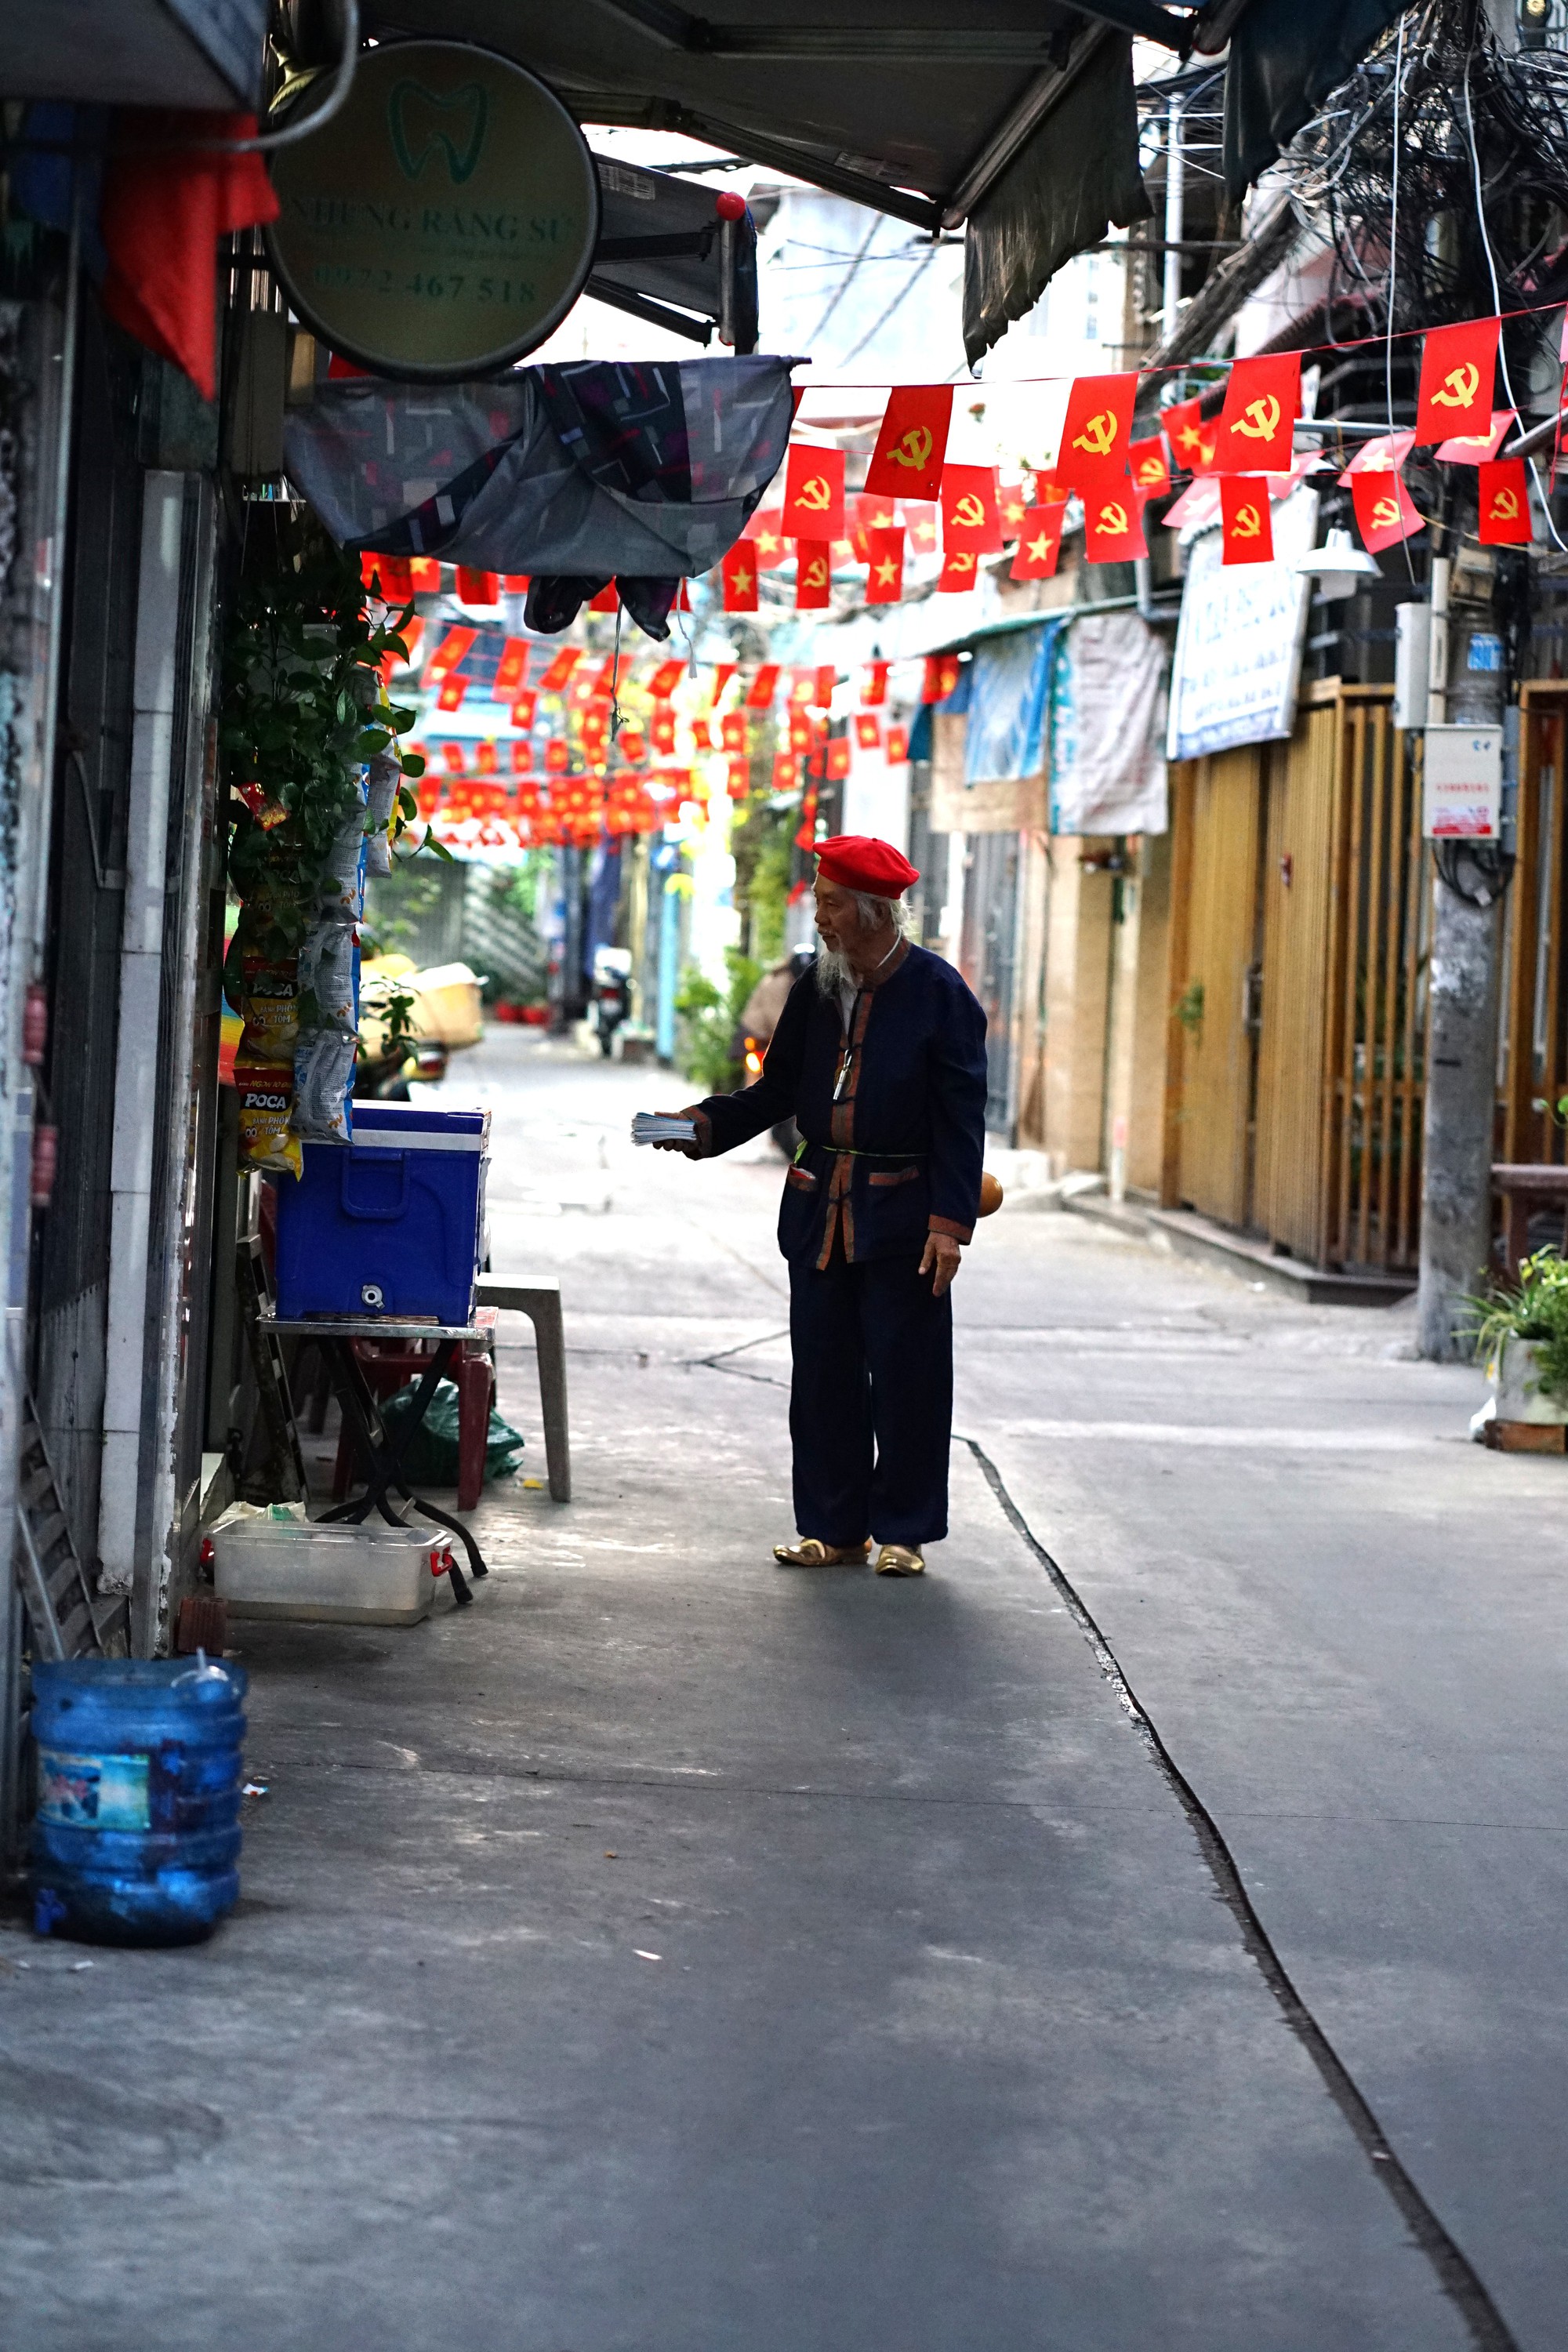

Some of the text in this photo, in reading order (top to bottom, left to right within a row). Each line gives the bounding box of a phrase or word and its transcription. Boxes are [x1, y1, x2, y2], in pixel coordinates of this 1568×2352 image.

[312, 267, 536, 303] 0972 467 518
[245, 1093, 286, 1109] POCA
[265, 1124, 281, 1134] TÔM
